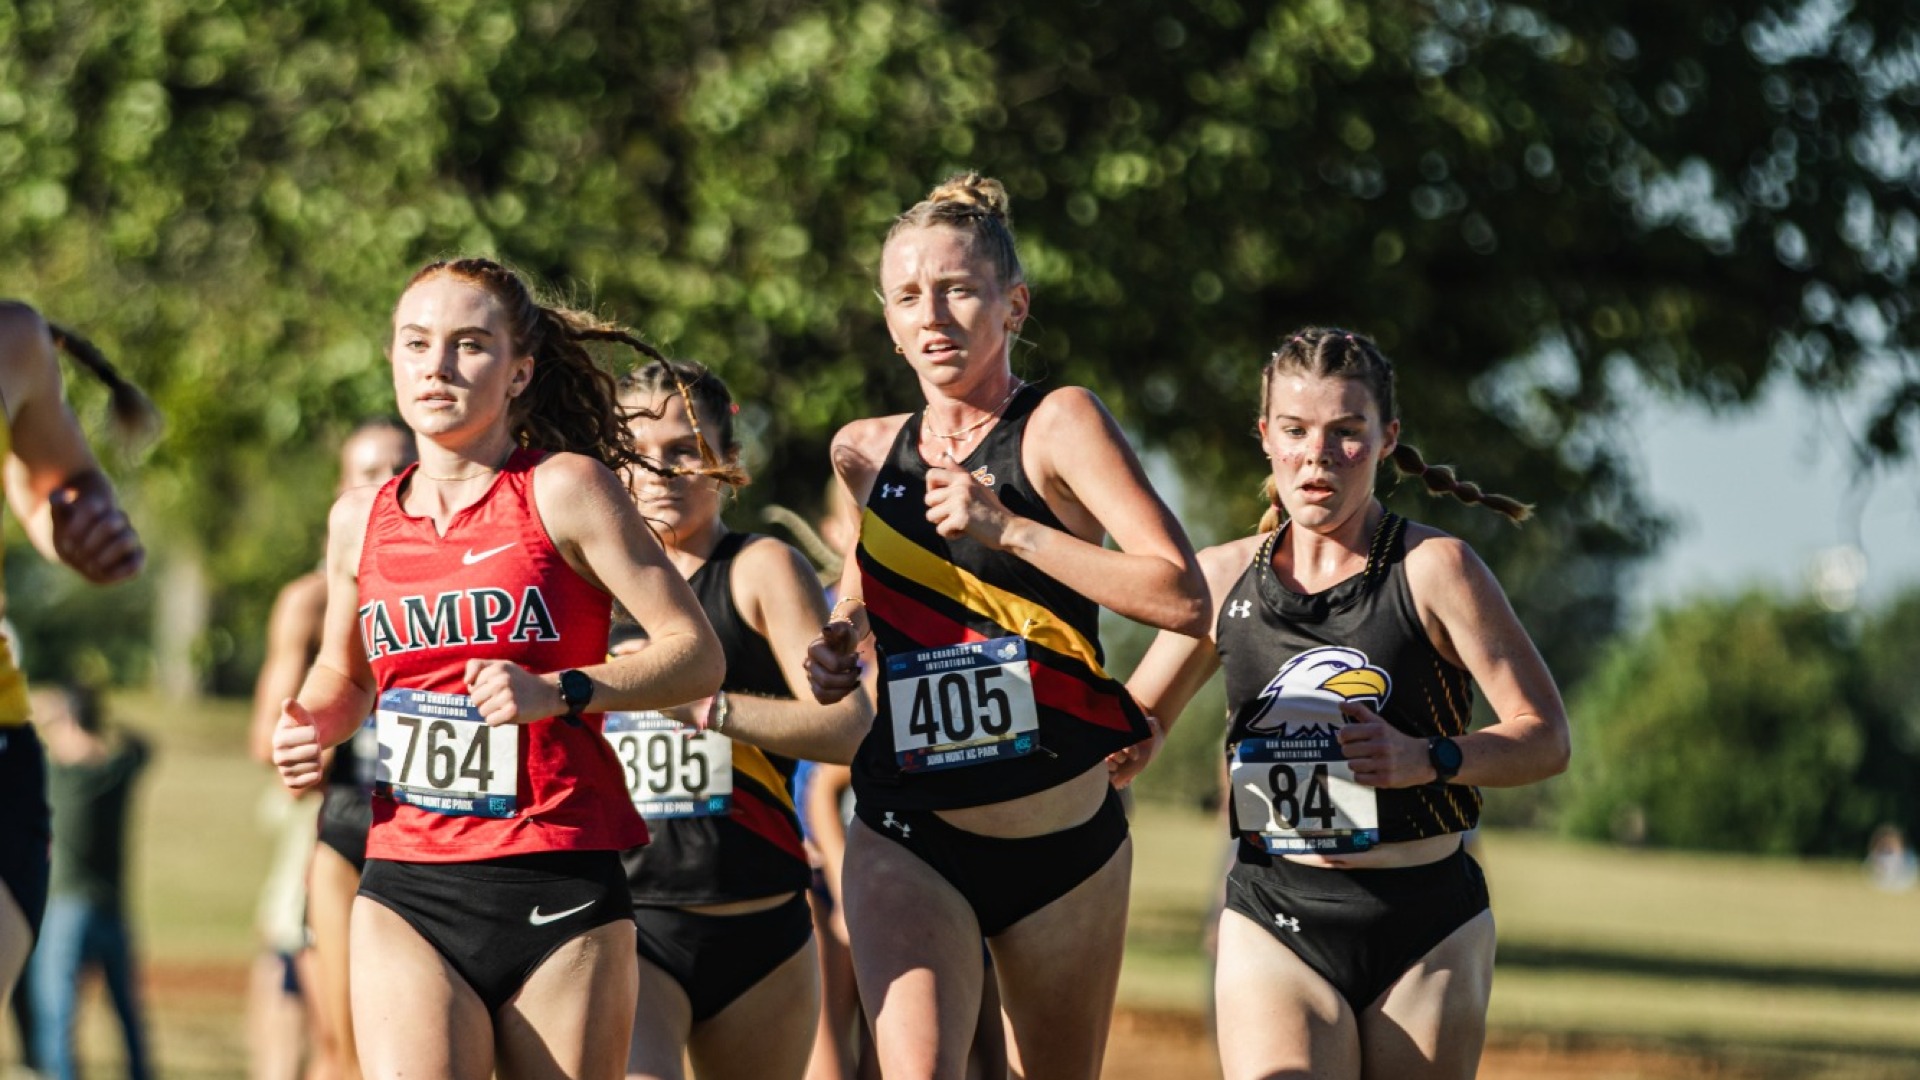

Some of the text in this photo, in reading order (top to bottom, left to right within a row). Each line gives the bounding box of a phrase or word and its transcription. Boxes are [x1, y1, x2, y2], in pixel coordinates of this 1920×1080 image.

[925, 656, 976, 671] INVITATIONAL
[909, 667, 1012, 745] 405
[397, 715, 494, 792] 764
[618, 733, 710, 794] 395
[977, 745, 999, 758] PARK
[1273, 750, 1322, 759] INVITATIONAL
[1268, 763, 1336, 829] 84
